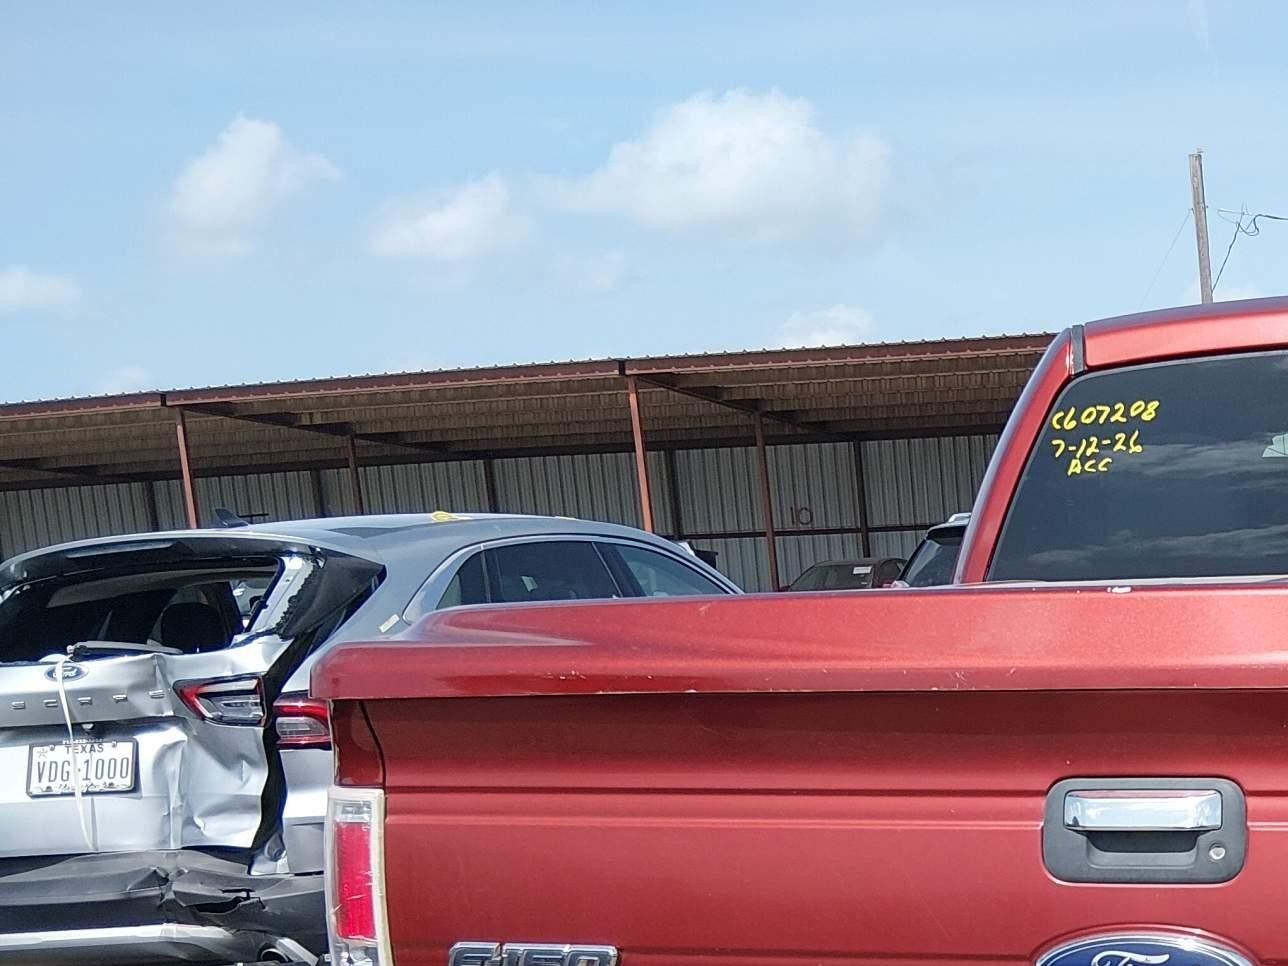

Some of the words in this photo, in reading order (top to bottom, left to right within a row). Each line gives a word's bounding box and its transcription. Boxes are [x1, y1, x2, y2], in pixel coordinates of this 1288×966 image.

[1052, 399, 1161, 431] C607208
[1050, 430, 1144, 458] 7-12-26
[1066, 457, 1113, 477] ACC
[64, 742, 105, 755] TEXAS
